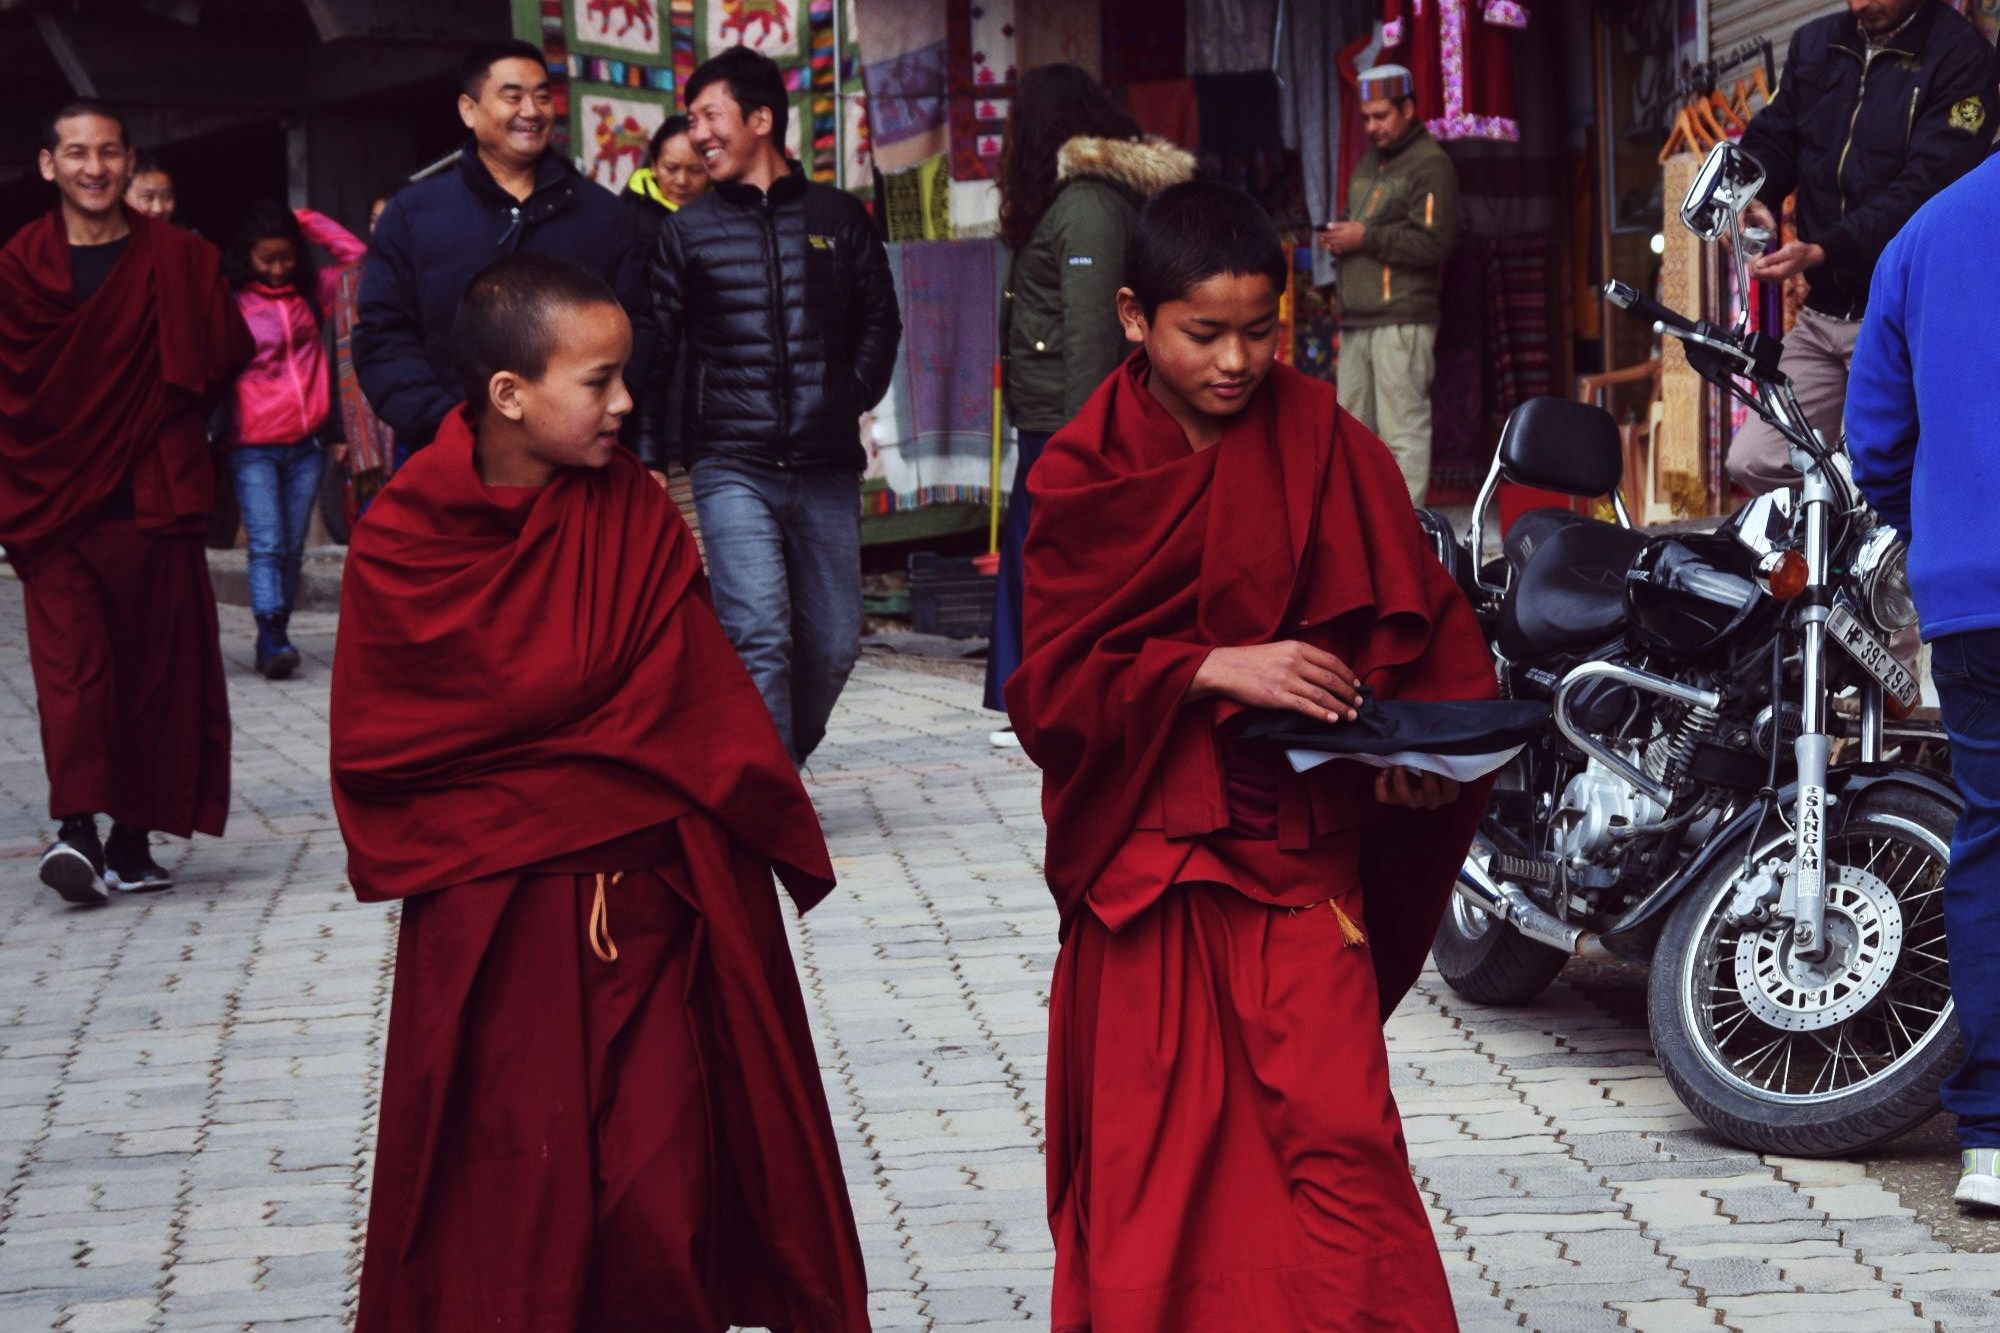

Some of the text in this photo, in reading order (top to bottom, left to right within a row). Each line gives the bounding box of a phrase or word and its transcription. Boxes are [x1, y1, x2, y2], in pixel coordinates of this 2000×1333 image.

[1843, 622, 1915, 701] HP 39C 2945
[1802, 795, 1819, 870] SANGAM
